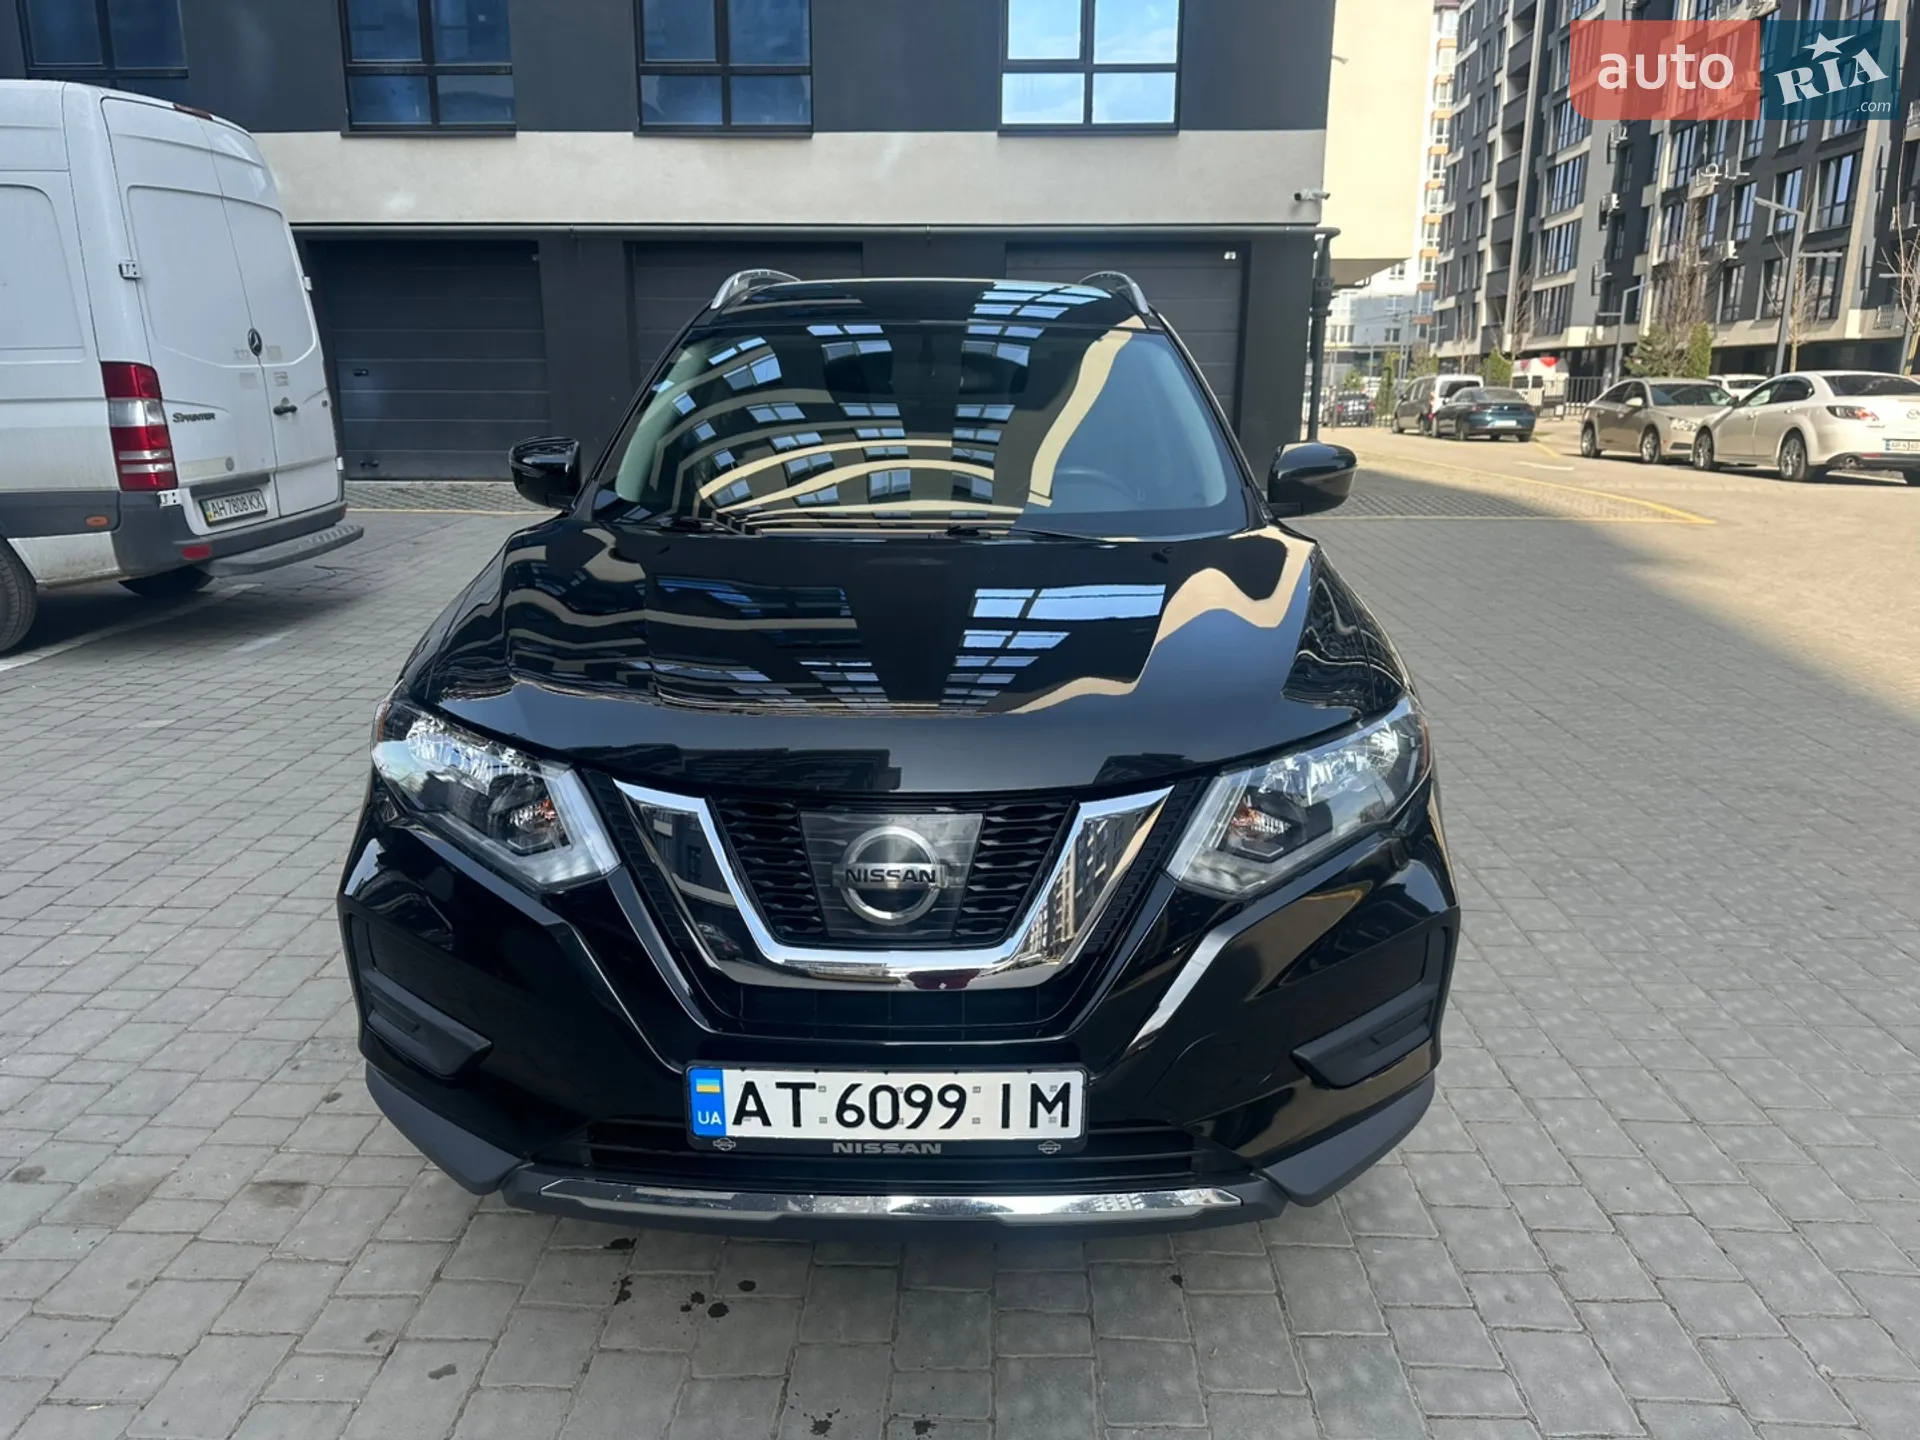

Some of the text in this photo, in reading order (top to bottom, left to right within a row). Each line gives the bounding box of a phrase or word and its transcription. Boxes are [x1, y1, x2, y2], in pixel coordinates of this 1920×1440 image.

[211, 500, 227, 517] AH
[247, 493, 264, 510] KX
[845, 868, 936, 883] NISSAN
[732, 1080, 1071, 1130] AT 6099 IM
[698, 1110, 722, 1125] UA
[832, 1142, 942, 1154] NISSAN
